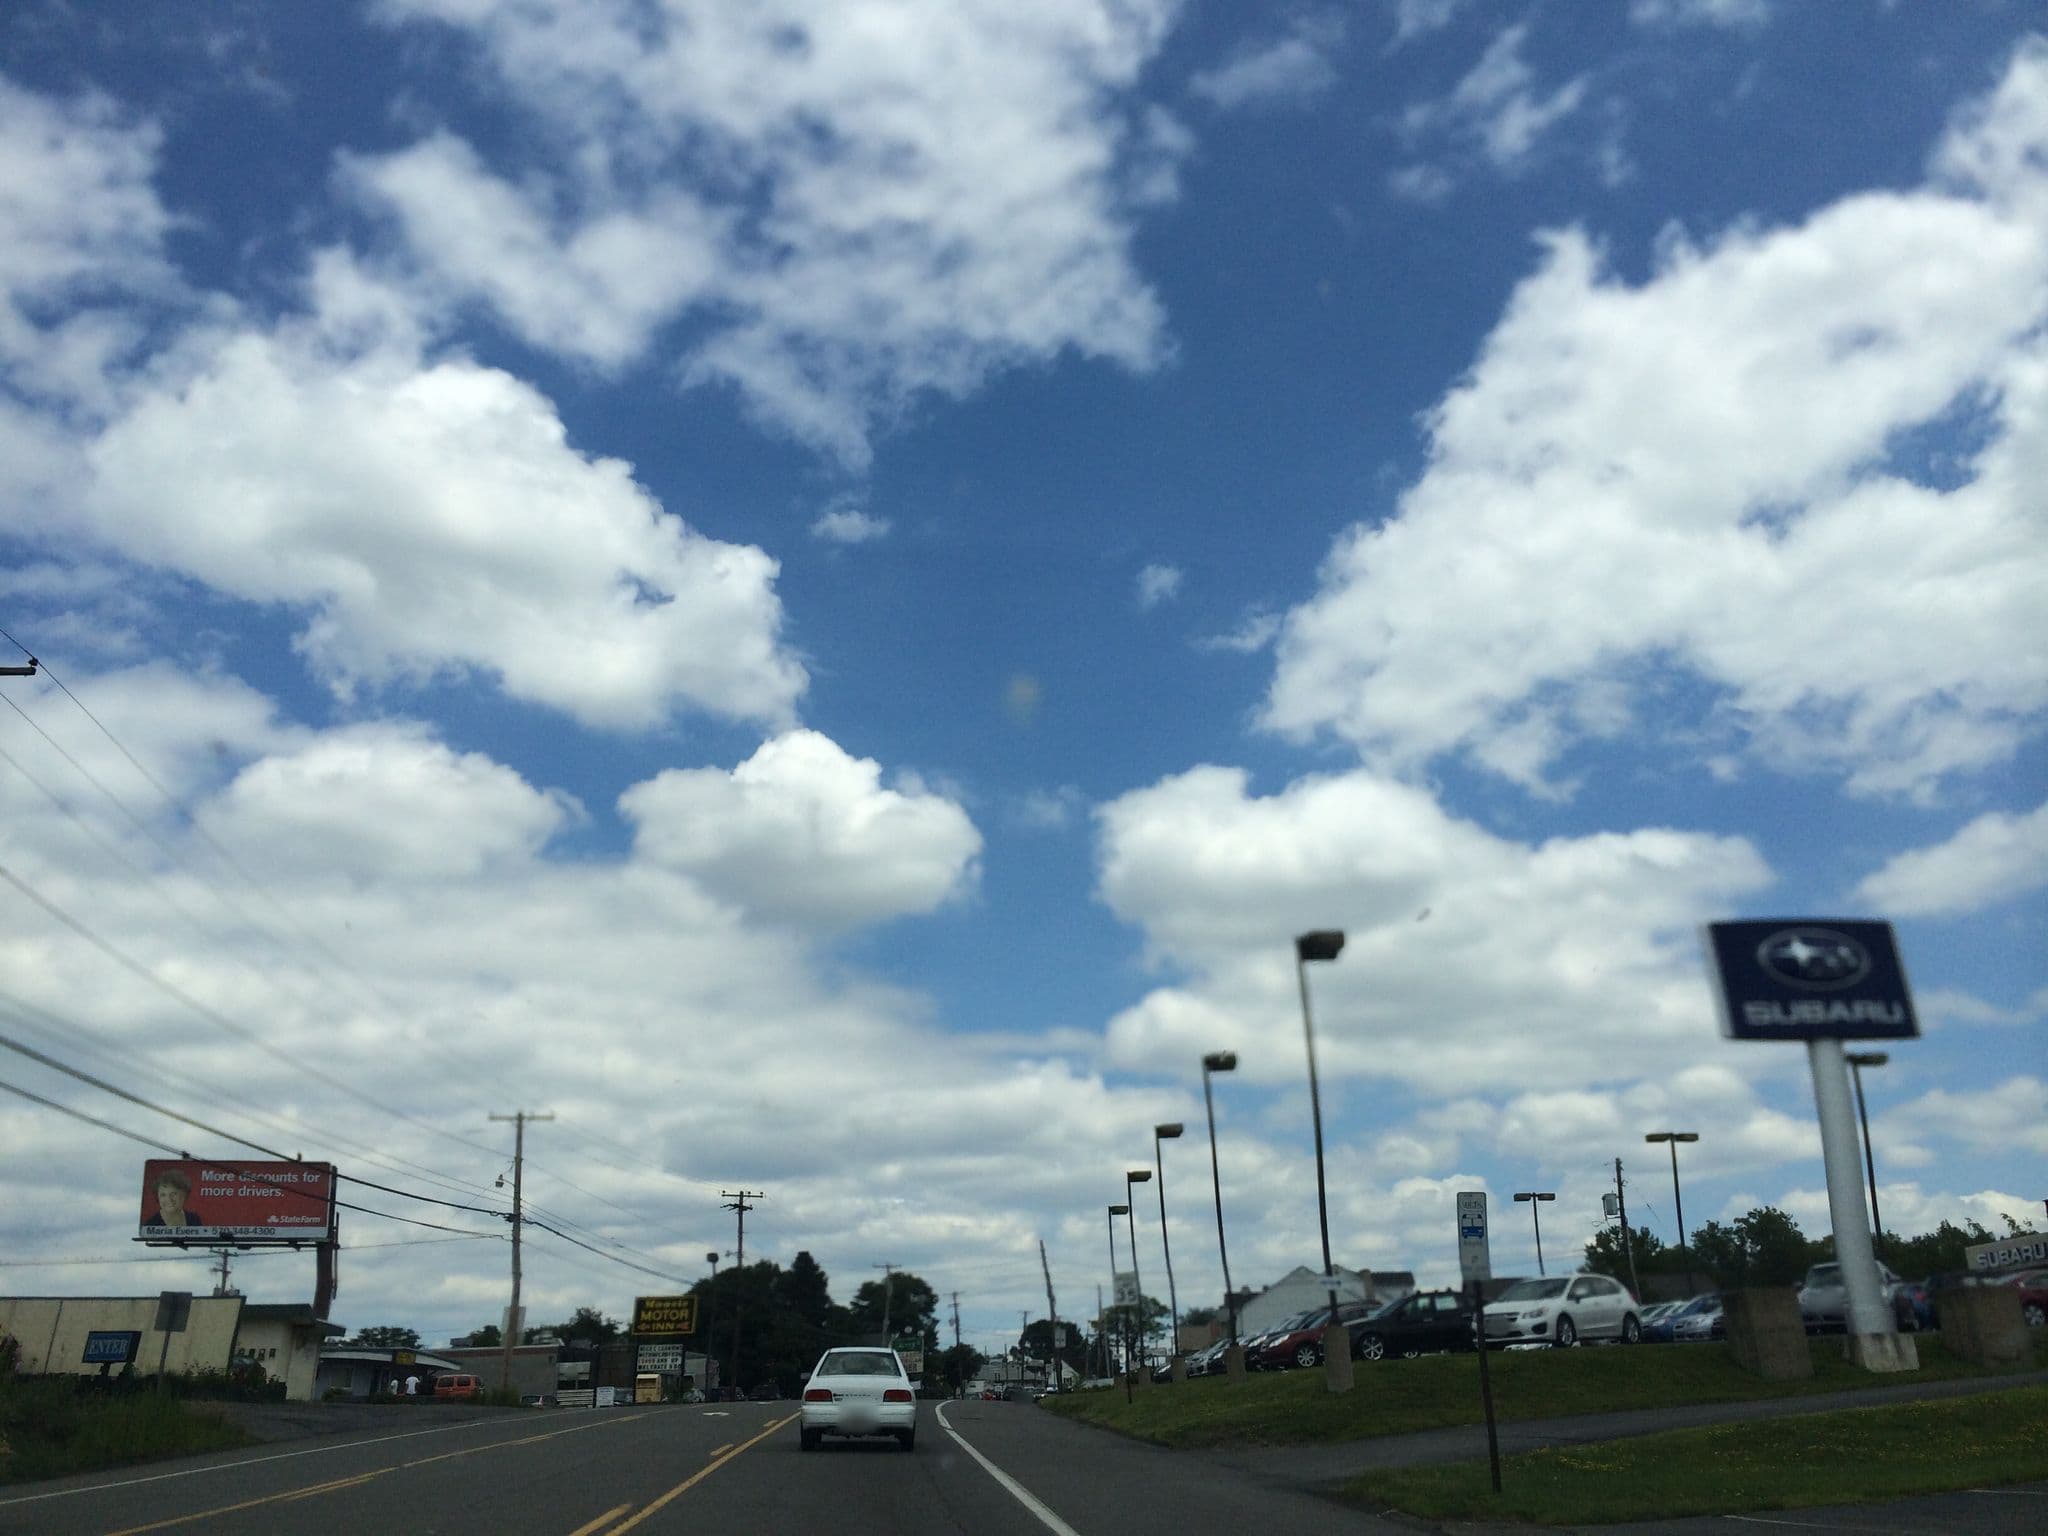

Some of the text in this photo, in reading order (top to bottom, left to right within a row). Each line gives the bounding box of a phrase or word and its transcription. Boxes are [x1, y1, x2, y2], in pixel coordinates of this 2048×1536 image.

[1744, 1001, 1904, 1026] SUBARU
[201, 1171, 235, 1182] More
[302, 1171, 320, 1183] for
[200, 1186, 285, 1197] more drivers.
[146, 1227, 173, 1235] Maria
[1976, 1242, 2047, 1269] SUBARU
[640, 1309, 689, 1320] MOTOR
[652, 1322, 675, 1330] INN
[88, 1339, 129, 1355] ENTER
